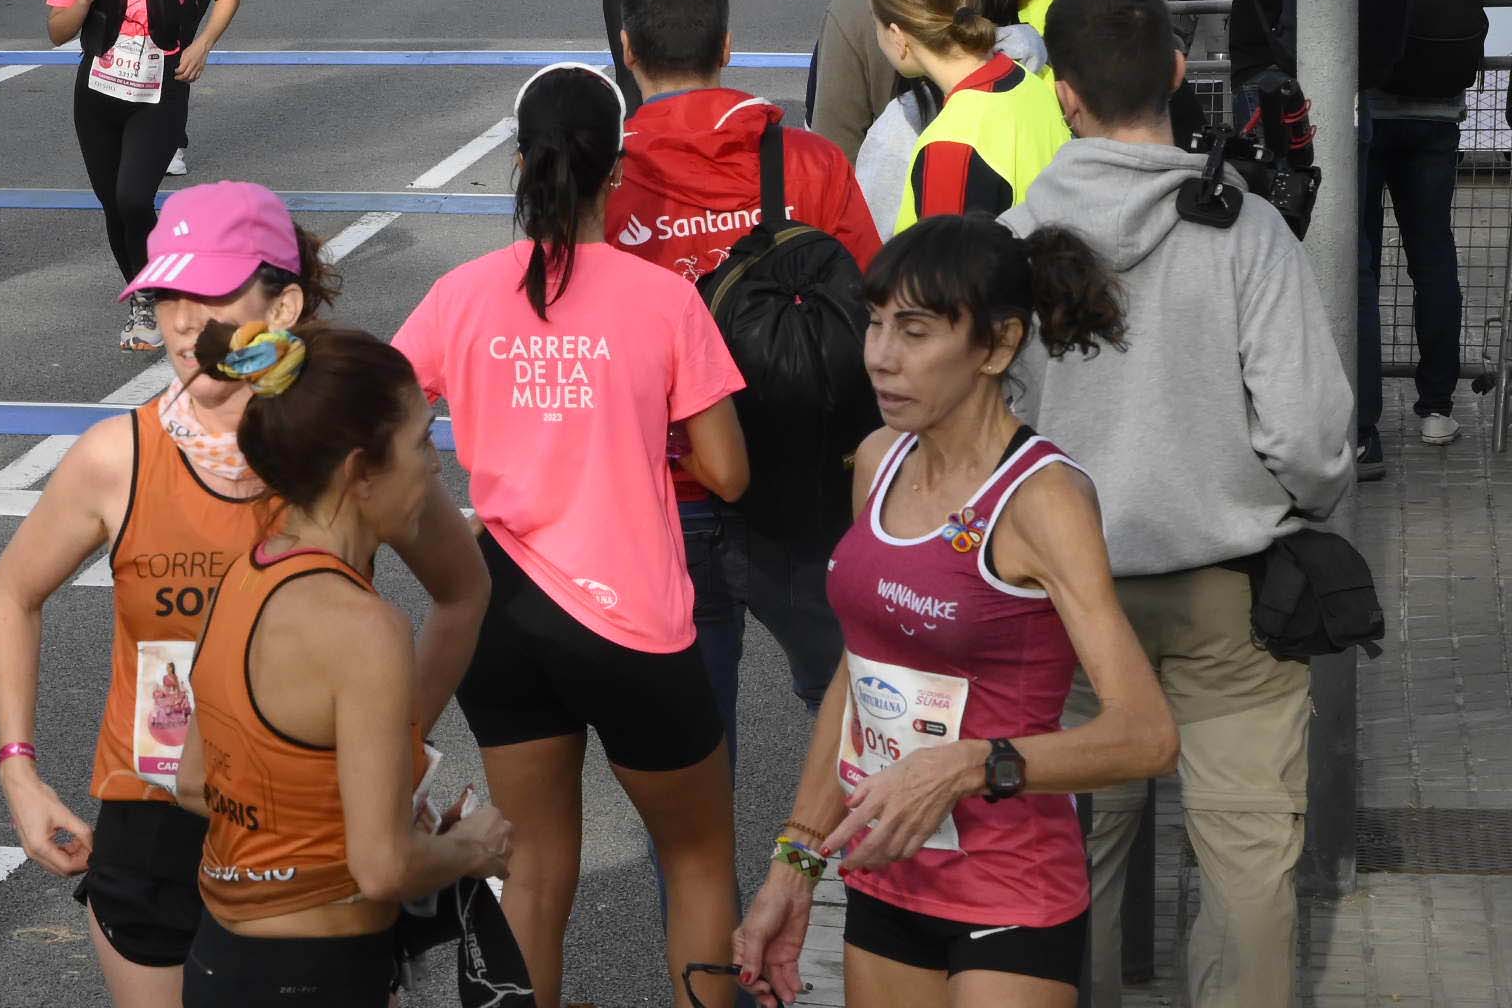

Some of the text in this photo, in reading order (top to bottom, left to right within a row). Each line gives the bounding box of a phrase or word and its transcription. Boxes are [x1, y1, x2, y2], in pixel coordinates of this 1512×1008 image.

[488, 335, 611, 361] CARRERA
[514, 360, 589, 384] DE LA
[511, 385, 594, 409] MUJER
[543, 413, 563, 422] 2023
[876, 577, 958, 622] WANAWAKE
[915, 695, 951, 710] SUMA
[864, 726, 902, 762] 016
